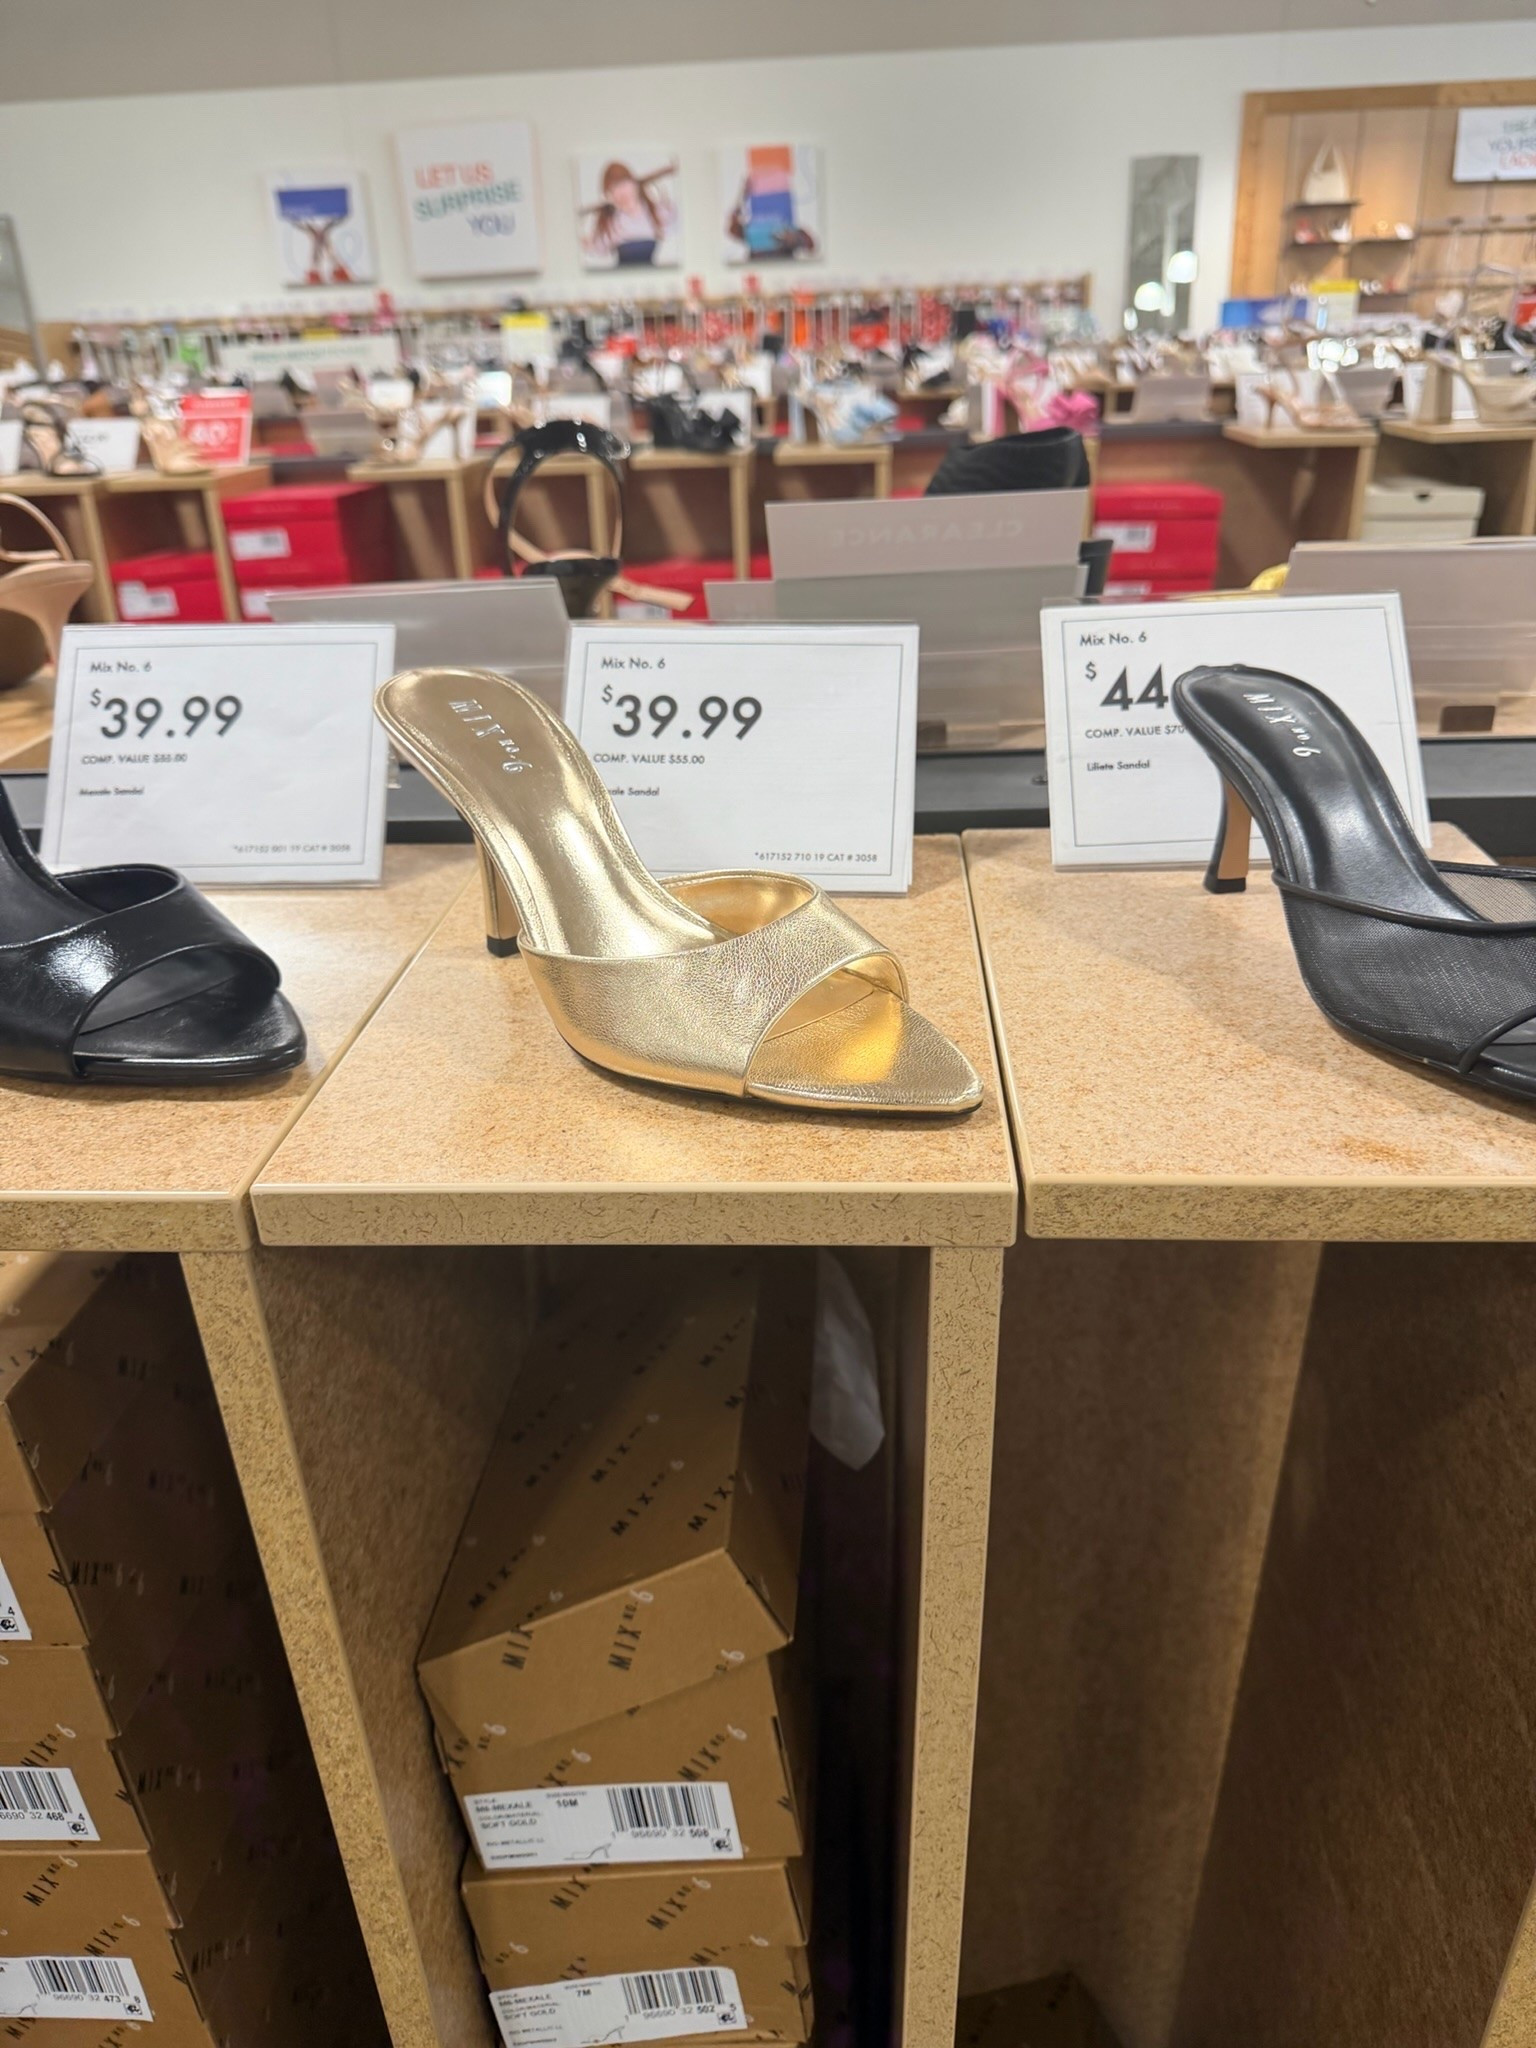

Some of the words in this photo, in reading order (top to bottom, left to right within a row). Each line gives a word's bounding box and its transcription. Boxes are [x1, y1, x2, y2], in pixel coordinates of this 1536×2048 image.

[415, 162, 457, 190] LET
[459, 160, 495, 187] US
[413, 178, 523, 221] SURPRISE
[466, 213, 516, 237] YOU
[1080, 635, 1105, 646] Mix
[1109, 633, 1134, 645] No.
[1138, 632, 1147, 643] 6
[90, 662, 113, 673] Mix
[117, 661, 140, 673] No.
[143, 662, 152, 672] 6
[600, 658, 625, 669] Mix
[629, 658, 653, 669] No.
[657, 658, 666, 669] 6
[1085, 661, 1169, 711] $44
[90, 688, 243, 739] $39.99
[601, 684, 762, 740] $39.99
[1243, 693, 1296, 724] MIX
[1292, 747, 1321, 757] 6
[448, 699, 505, 738] MIX
[502, 761, 533, 774] 6
[1085, 729, 1122, 739] COMP.
[1125, 726, 1161, 737] VALUE
[1164, 725, 1185, 735] $70
[81, 755, 115, 765] COMP.
[118, 754, 150, 764] VALUE
[593, 754, 629, 764] COMP.
[632, 754, 666, 764] VALUE
[668, 755, 705, 765] $55.00
[1117, 760, 1150, 770] Sandal
[628, 786, 660, 796] Sandal
[795, 853, 811, 861] 710
[815, 853, 824, 861] 19
[827, 853, 845, 861] CAT
[855, 854, 878, 862] 3058
[591, 1443, 631, 1482] MIX
[610, 1492, 653, 1535] MIX
[687, 1486, 733, 1531] MIX
[468, 1566, 512, 1611] MIX
[608, 1625, 642, 1671] MIX
[56, 1723, 76, 1738] 6
[678, 1746, 721, 1782] MIX
[0, 1811, 26, 1820] 6690
[30, 1811, 43, 1820] 32
[47, 1812, 65, 1821] 468
[78, 1812, 85, 1821] 4
[23, 1874, 60, 1906] MIX
[59, 1854, 78, 1868] 6
[549, 1874, 590, 1910] MIX
[646, 1897, 687, 1930] MIX
[84, 1928, 119, 1956] MIX
[122, 1914, 140, 1927] 6
[53, 1993, 84, 2001] 96690
[104, 1994, 121, 2003] 473
